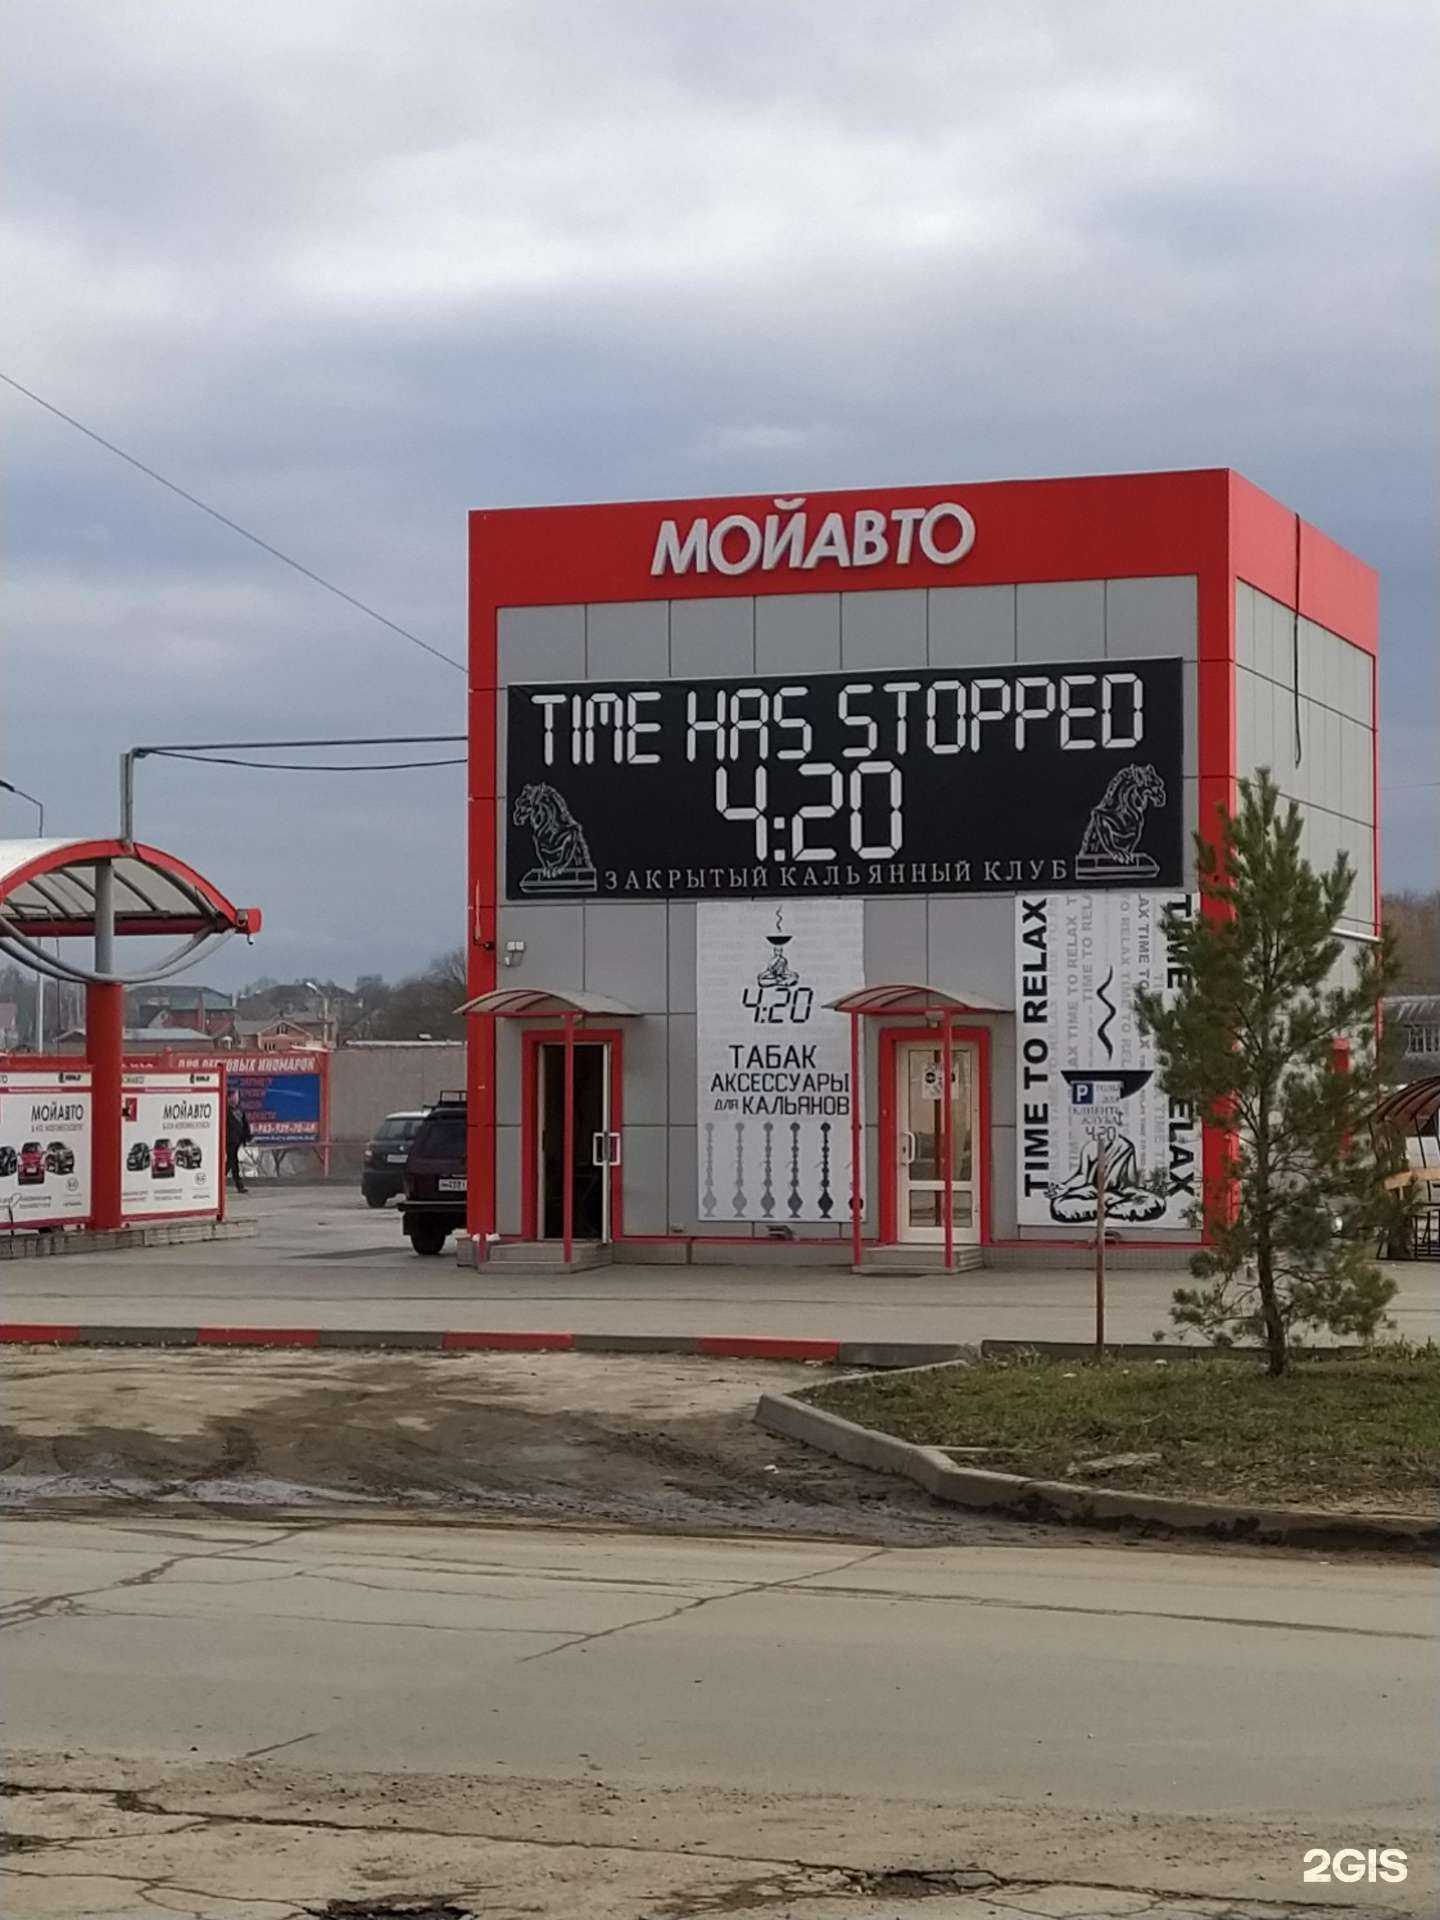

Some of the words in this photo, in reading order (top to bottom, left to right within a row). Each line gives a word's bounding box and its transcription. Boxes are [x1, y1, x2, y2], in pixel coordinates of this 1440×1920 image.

[650, 497, 976, 576] МОЙАВТО
[531, 691, 662, 766] TIME
[687, 687, 812, 762] HAS
[838, 673, 1144, 757] STOPPED
[715, 760, 902, 862] 4:20
[605, 866, 768, 890] ЗАКРЫТЫЙ
[778, 859, 972, 888] КАЛЬЯННЫЙ
[983, 858, 1068, 882] КЛУБ
[1023, 898, 1048, 1023] RELAX
[1138, 923, 1150, 965] TIME
[742, 987, 814, 1024] 4:20
[729, 1045, 817, 1069] ТАБАК
[1024, 1038, 1049, 1090] TO
[710, 1072, 850, 1093] АКСЕССУАРЫ
[1076, 1085, 1088, 1102] P
[31, 1101, 84, 1121] МОЙАВТО
[163, 1100, 212, 1120] МОЙАВТО
[742, 1095, 850, 1116] КАЛЬЯНОВ
[1025, 1103, 1049, 1198] TIME
[1168, 1096, 1194, 1197] ELAX
